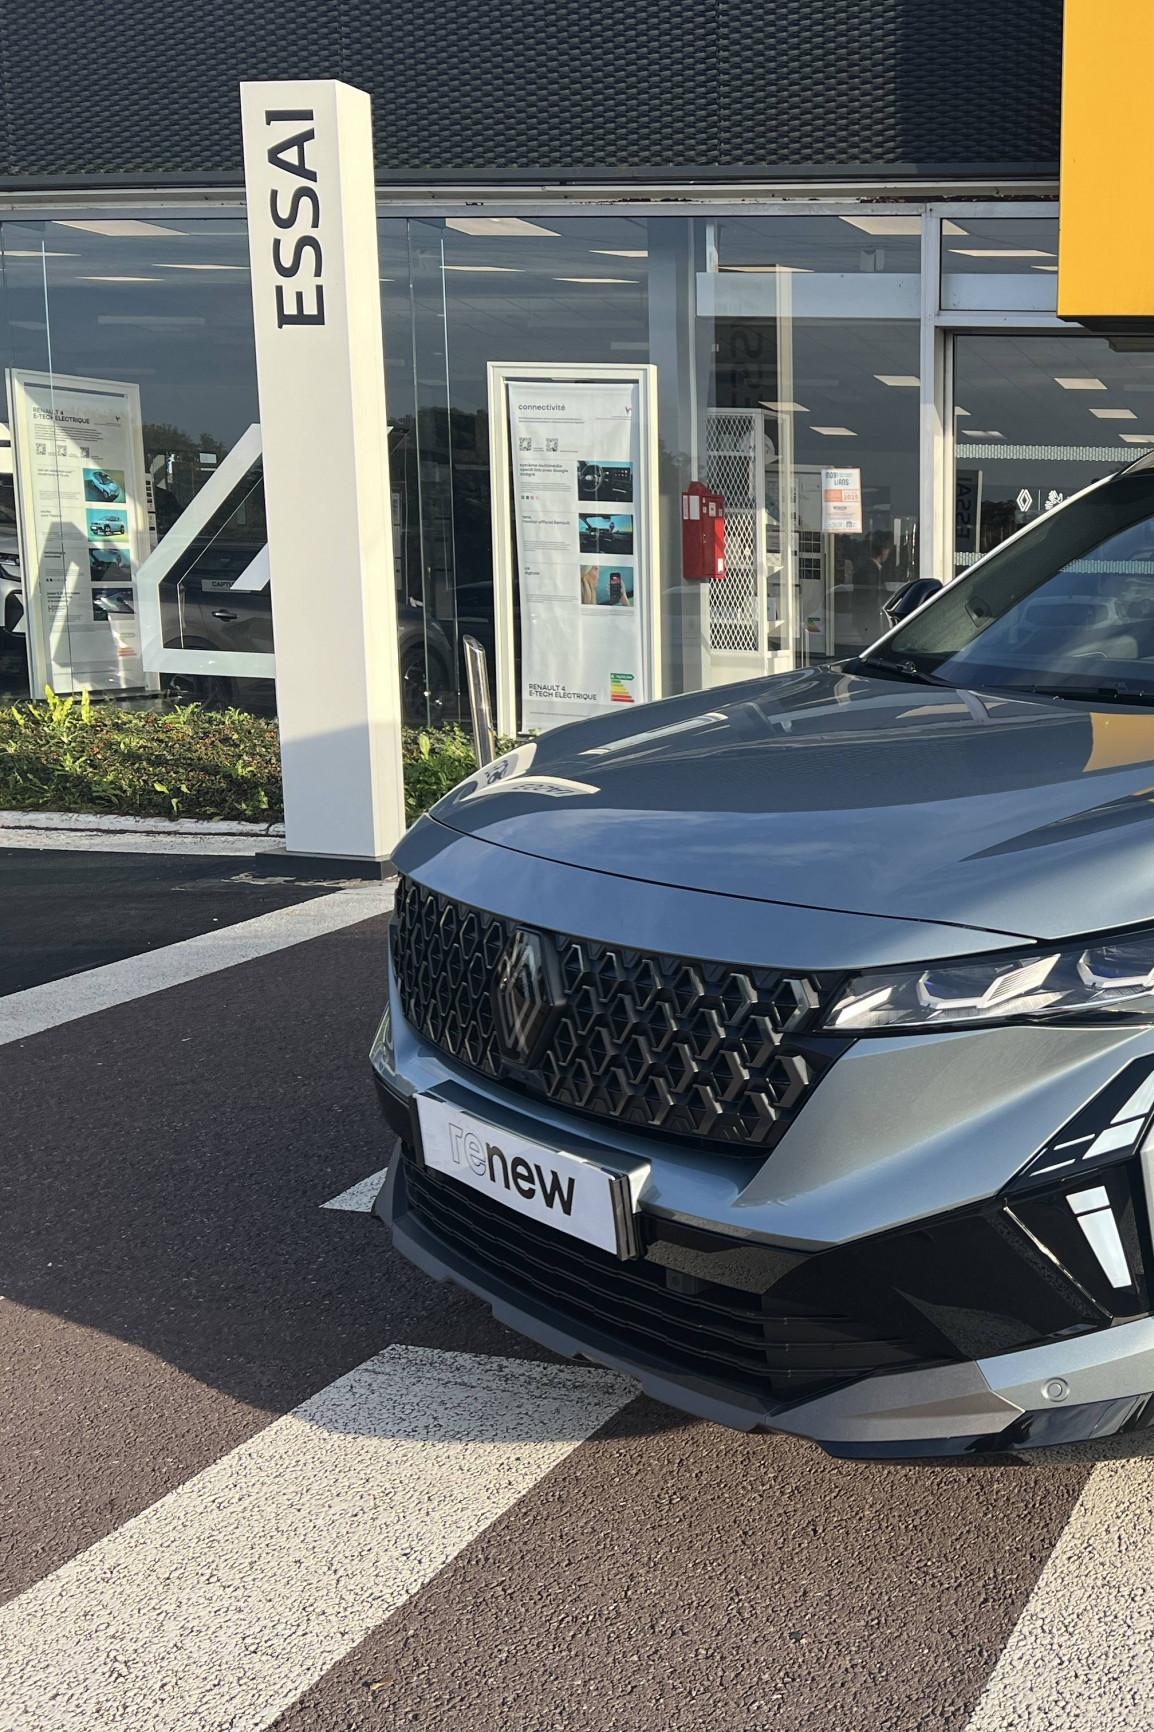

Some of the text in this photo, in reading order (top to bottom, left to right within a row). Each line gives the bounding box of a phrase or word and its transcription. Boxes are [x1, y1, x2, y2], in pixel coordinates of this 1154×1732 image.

[265, 109, 326, 330] ESSAI
[528, 683, 559, 691] RENAULT
[528, 690, 597, 701] E-TECH ELECTRIQUE
[448, 1122, 576, 1217] renew
